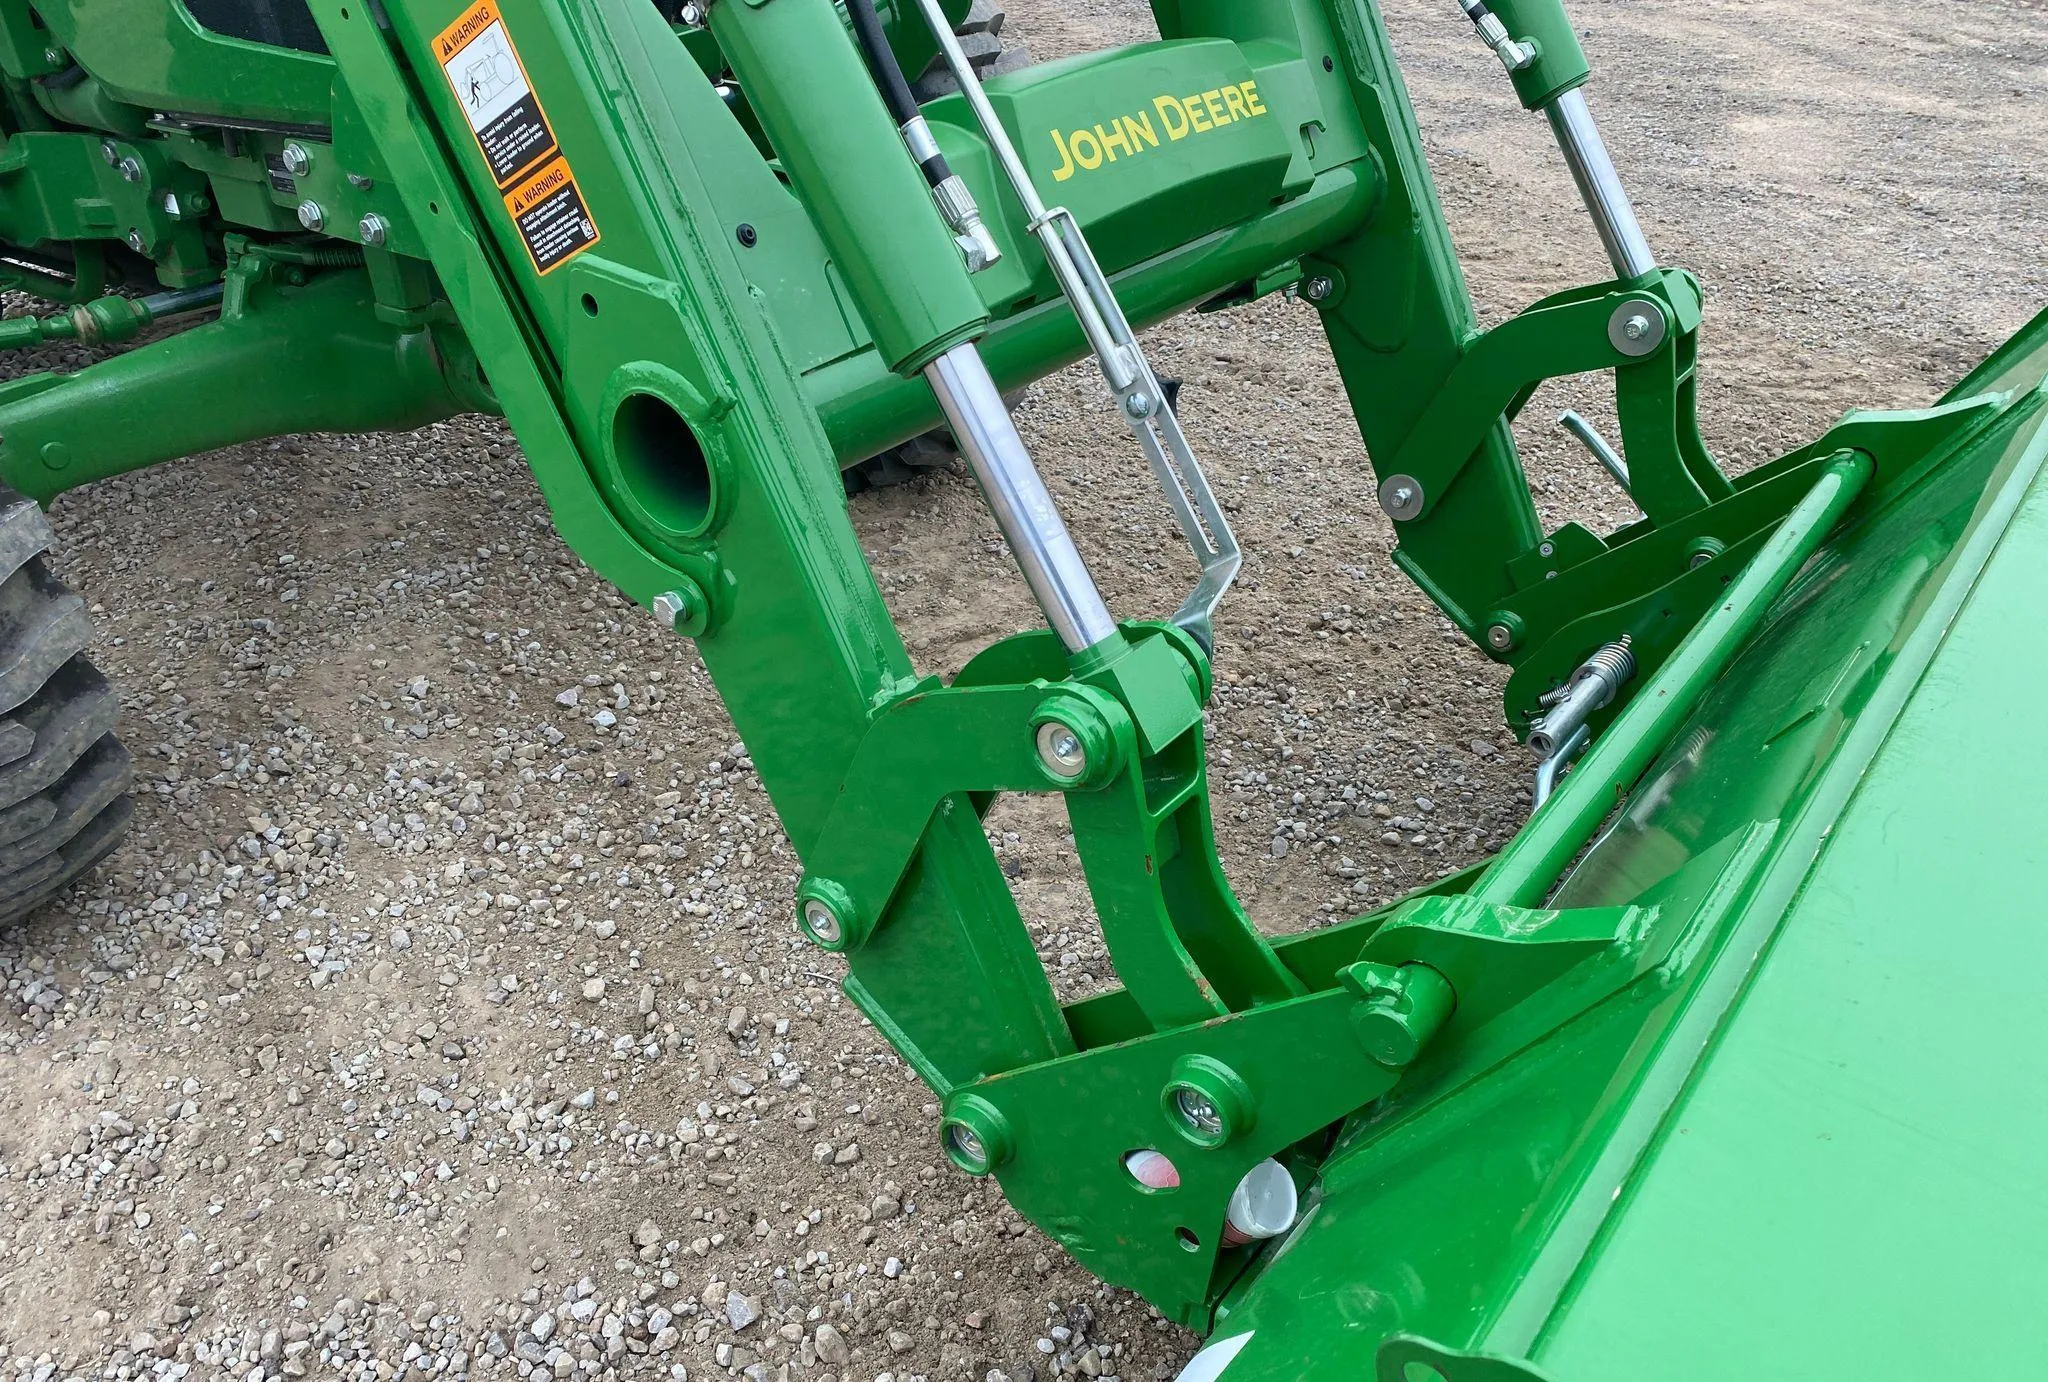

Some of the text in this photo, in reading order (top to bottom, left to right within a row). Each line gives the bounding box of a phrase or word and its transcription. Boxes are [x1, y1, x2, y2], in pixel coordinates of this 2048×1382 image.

[450, 6, 490, 47] WARNING
[1050, 80, 1267, 182] JOHN DEERE
[523, 169, 564, 203] WARNING
